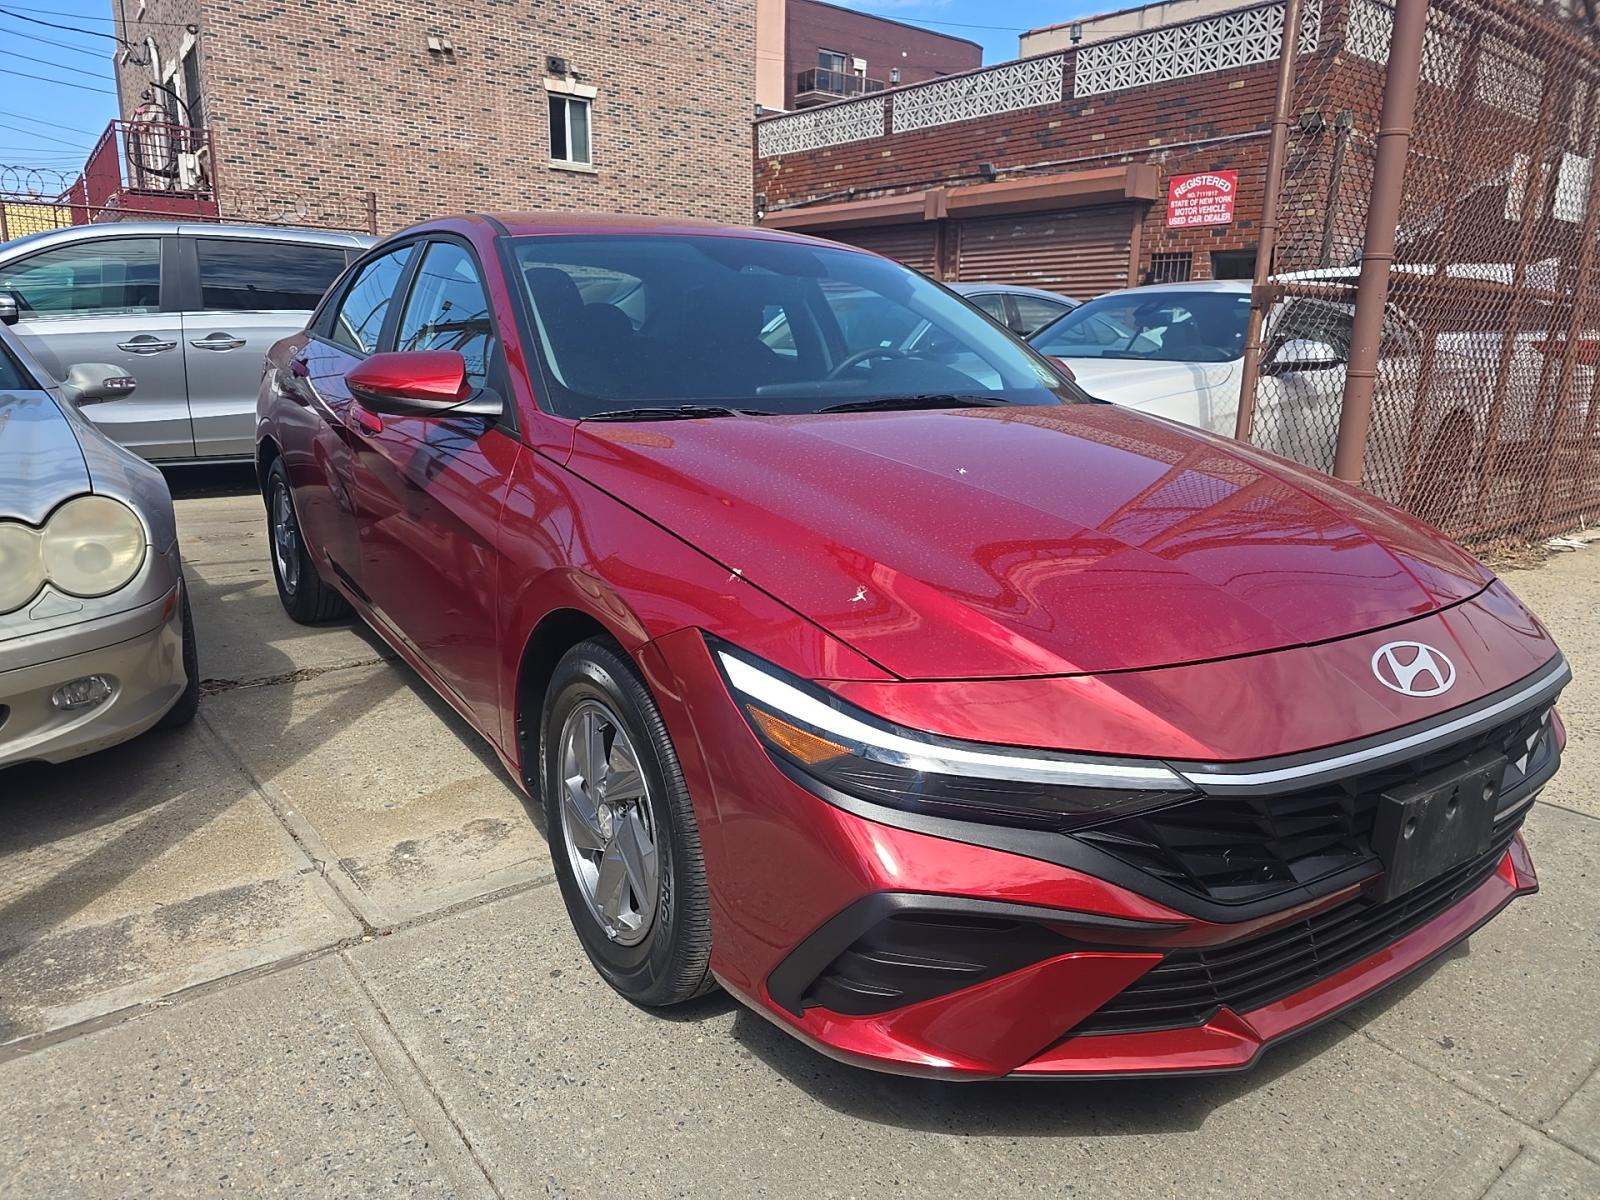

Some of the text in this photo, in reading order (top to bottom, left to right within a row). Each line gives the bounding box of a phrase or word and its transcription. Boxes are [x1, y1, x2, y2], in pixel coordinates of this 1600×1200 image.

[1174, 175, 1232, 198] REGISTERED
[1170, 200, 1189, 208] STATE
[1214, 195, 1232, 204] YORK
[1174, 204, 1227, 216] MOTOR VEHICLE
[1169, 212, 1231, 225] USED CAR DEALER
